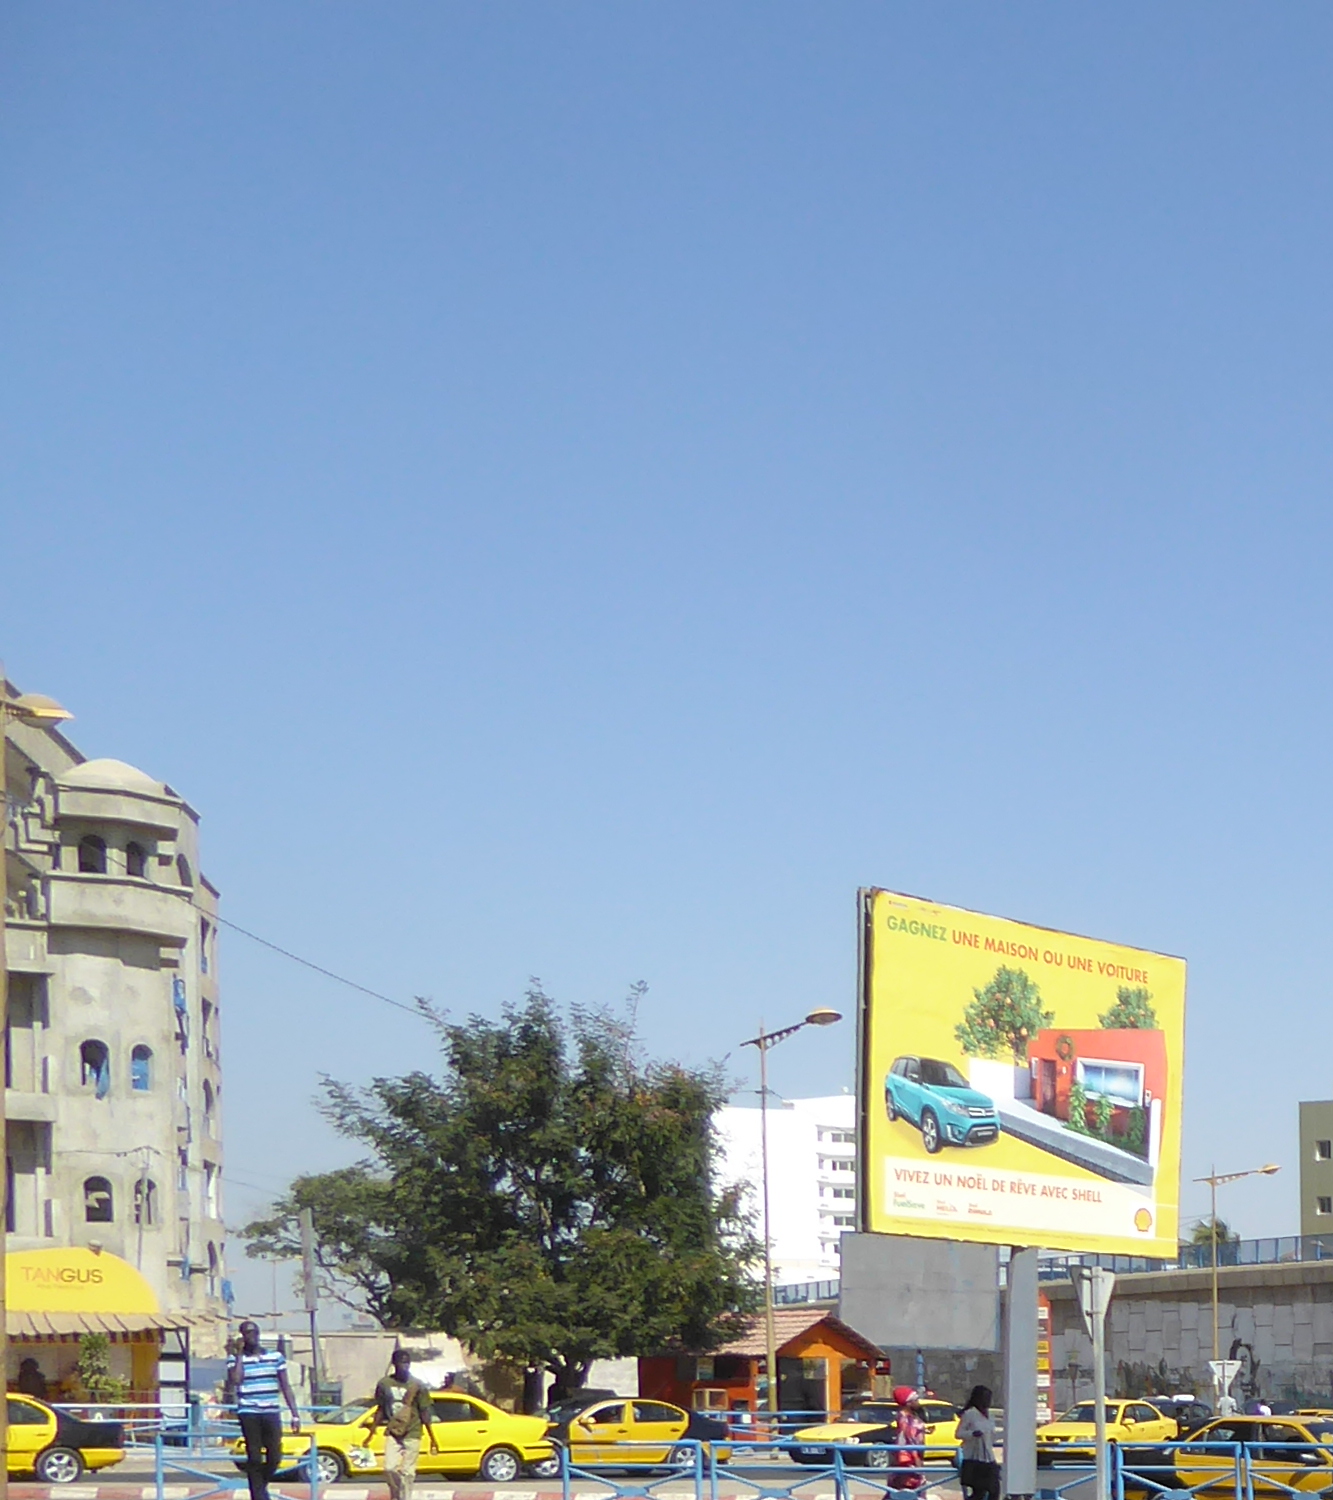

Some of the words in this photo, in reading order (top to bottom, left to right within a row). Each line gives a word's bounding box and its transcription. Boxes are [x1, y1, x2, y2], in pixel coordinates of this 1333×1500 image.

[887, 915, 947, 941] GAGNEZ
[952, 929, 980, 949] UNE
[984, 936, 1038, 961] MAISON
[1043, 950, 1063, 966] OU
[1067, 955, 1093, 973] UNE
[1097, 961, 1149, 984] VOITURE
[894, 1168, 929, 1184] VIVEZ
[934, 1173, 952, 1187] UN
[957, 1173, 988, 1191] NOËL
[992, 1179, 1006, 1193] DE
[1010, 1178, 1037, 1196] RÊVE
[1040, 1184, 1068, 1200] AVEC
[1072, 1187, 1103, 1203] SHELL
[20, 1266, 103, 1284] TANGUS
